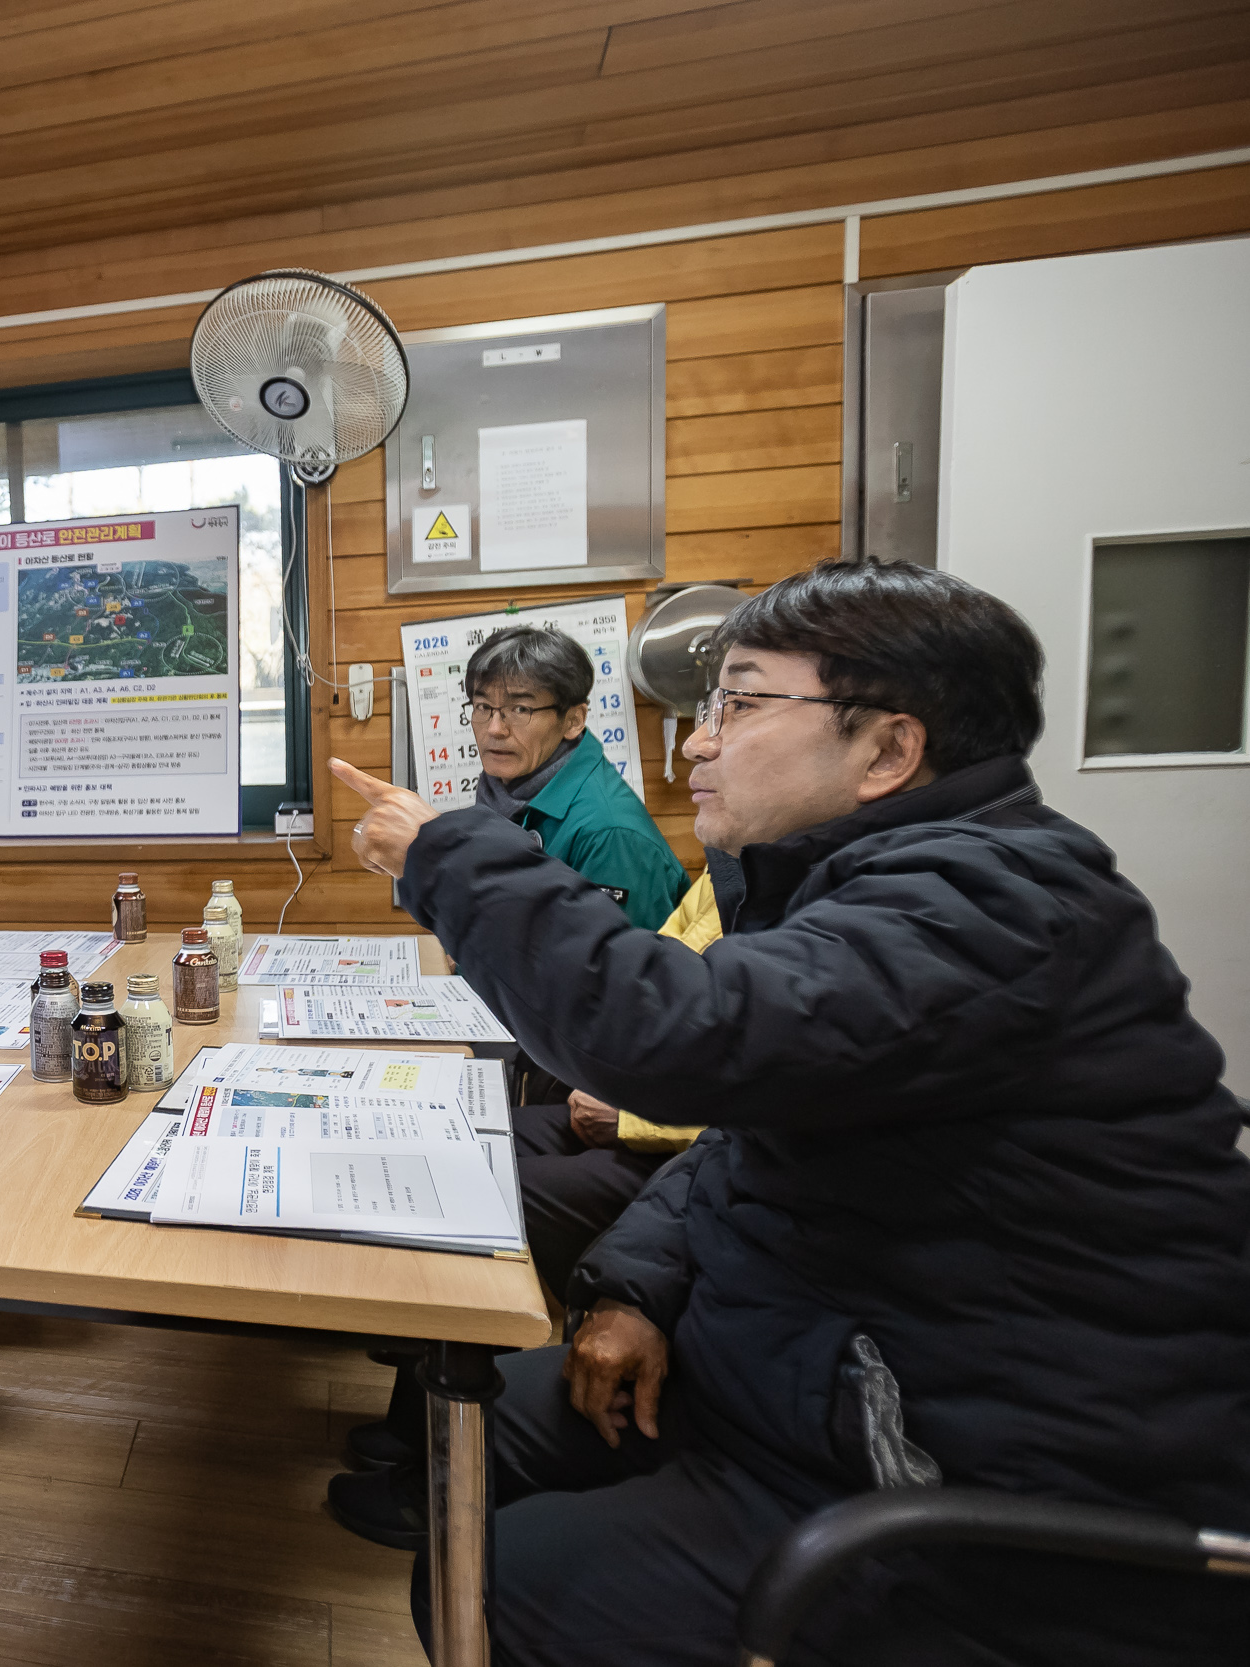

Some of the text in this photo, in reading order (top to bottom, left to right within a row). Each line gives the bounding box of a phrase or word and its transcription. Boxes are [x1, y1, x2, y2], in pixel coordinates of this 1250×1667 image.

[15, 530, 55, 547] 등산로
[58, 524, 141, 544] 안전관리계획
[25, 552, 94, 565] 아차산 등산로 현황
[593, 616, 617, 625] 4359
[414, 636, 449, 650] 2026
[414, 650, 449, 659] CALENDAR
[601, 661, 612, 675] 6
[600, 694, 620, 709] 13
[431, 715, 440, 729] 7
[603, 728, 625, 743] 20
[429, 747, 449, 762] 14
[458, 744, 478, 758] 15
[433, 780, 452, 795] 21
[73, 1040, 115, 1061] T.O.P
